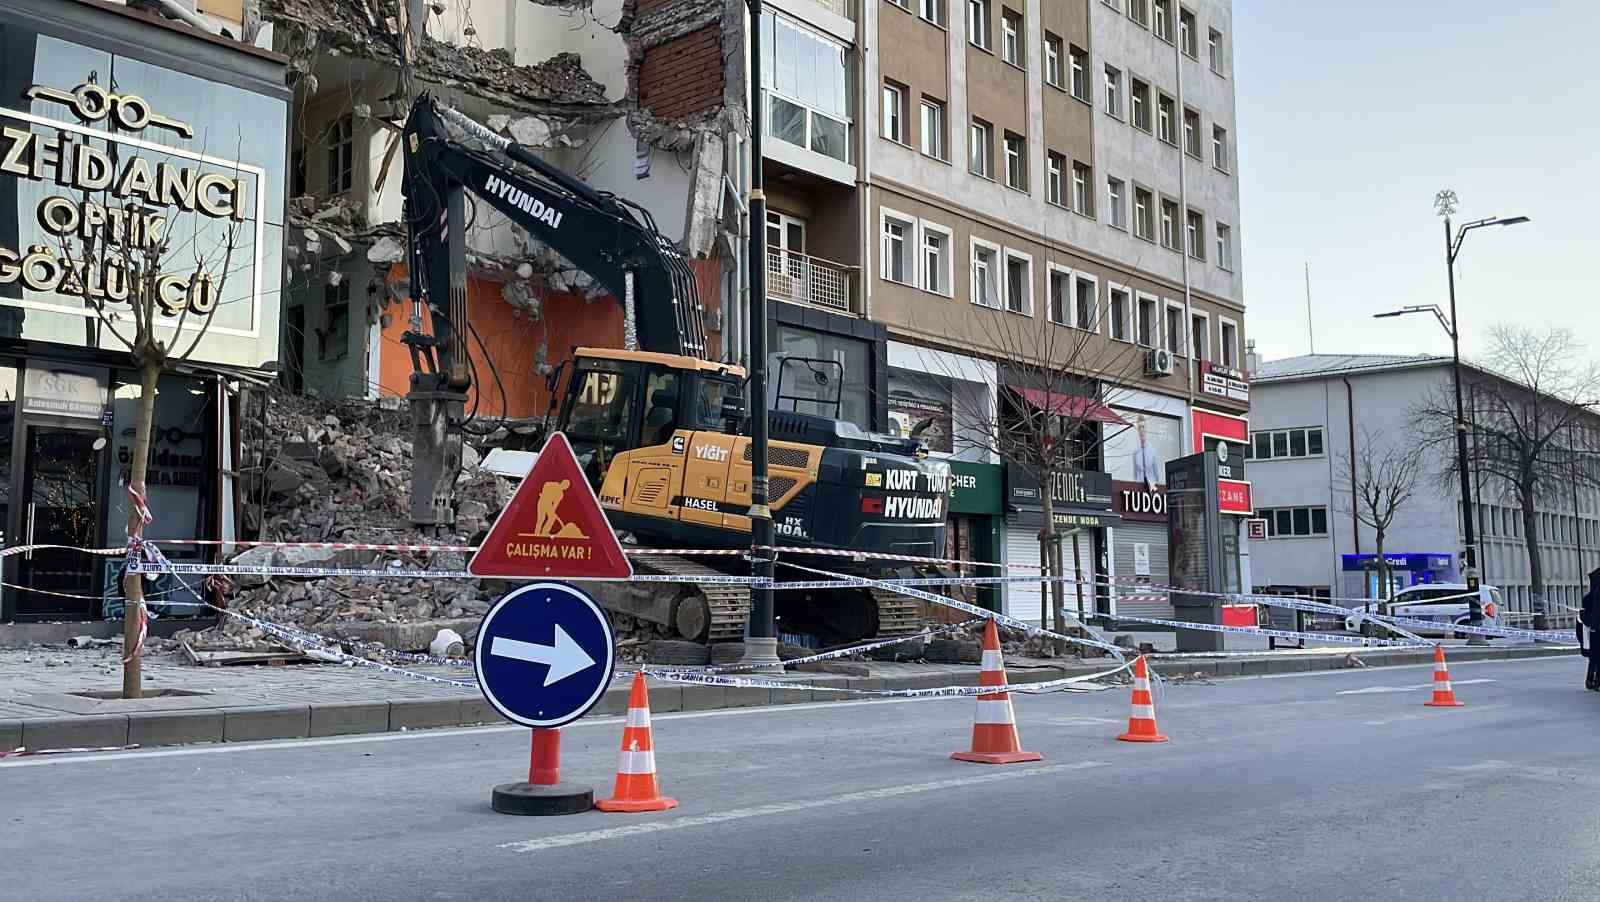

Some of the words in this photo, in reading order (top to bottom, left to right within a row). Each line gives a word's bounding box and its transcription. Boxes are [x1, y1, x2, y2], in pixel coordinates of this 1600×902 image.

[485, 174, 563, 229] HYUNDAI
[0, 244, 218, 316] GÖZLÜÇÜ
[696, 444, 728, 462] YİĞİT
[886, 469, 918, 491] KURT
[684, 497, 719, 511] HASEL
[885, 496, 943, 519] HYUNDAI
[775, 523, 809, 538] 10AL
[506, 542, 559, 559] ÇALIŞMA
[560, 544, 586, 559] VAR
